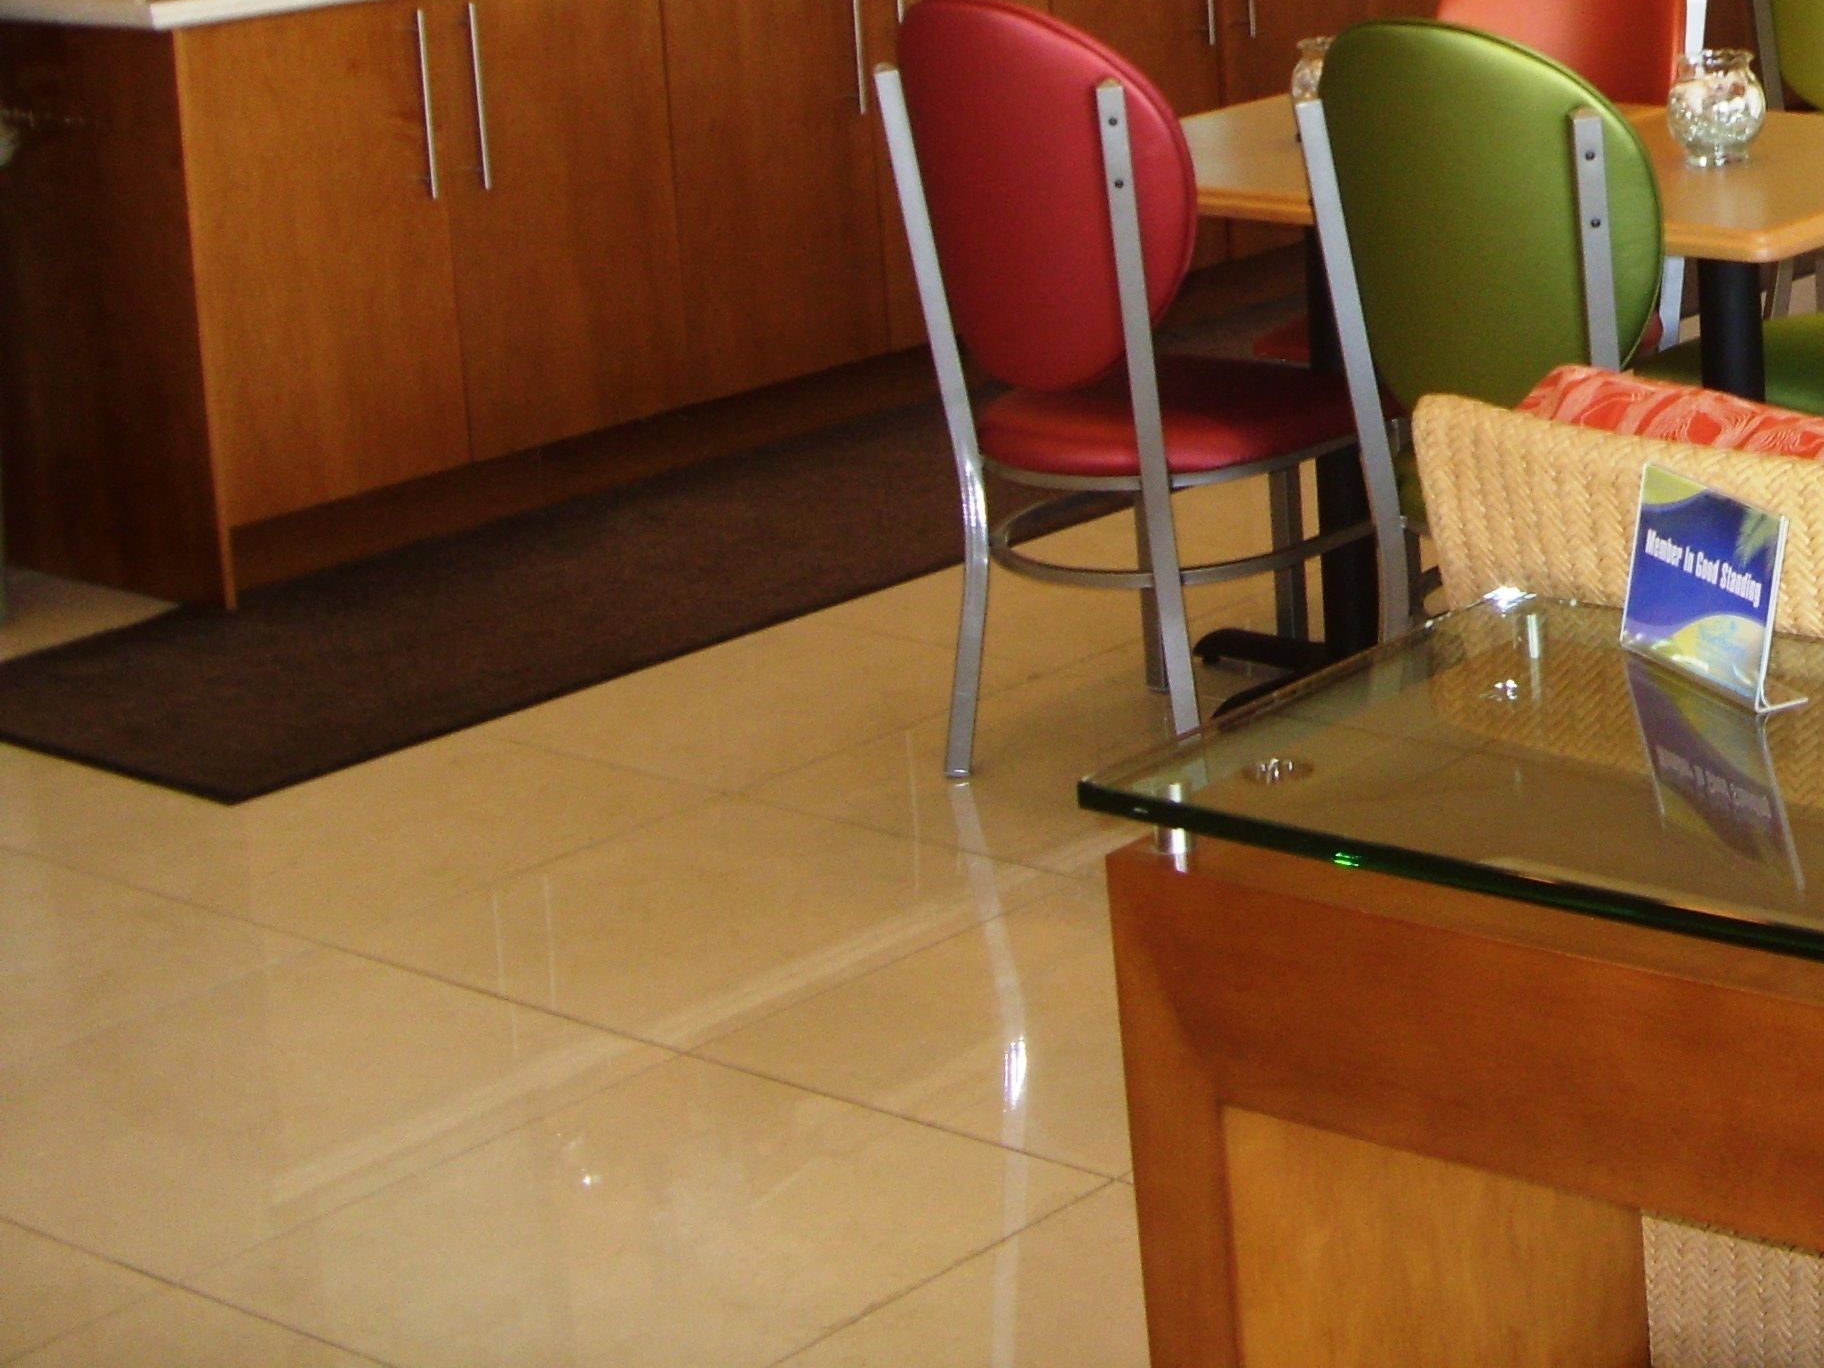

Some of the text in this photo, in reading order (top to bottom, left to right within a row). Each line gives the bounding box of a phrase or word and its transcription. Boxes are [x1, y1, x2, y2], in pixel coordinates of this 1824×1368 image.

[1645, 528, 1683, 567] Member
[1695, 551, 1720, 585] Good
[1719, 562, 1762, 608] Standing
